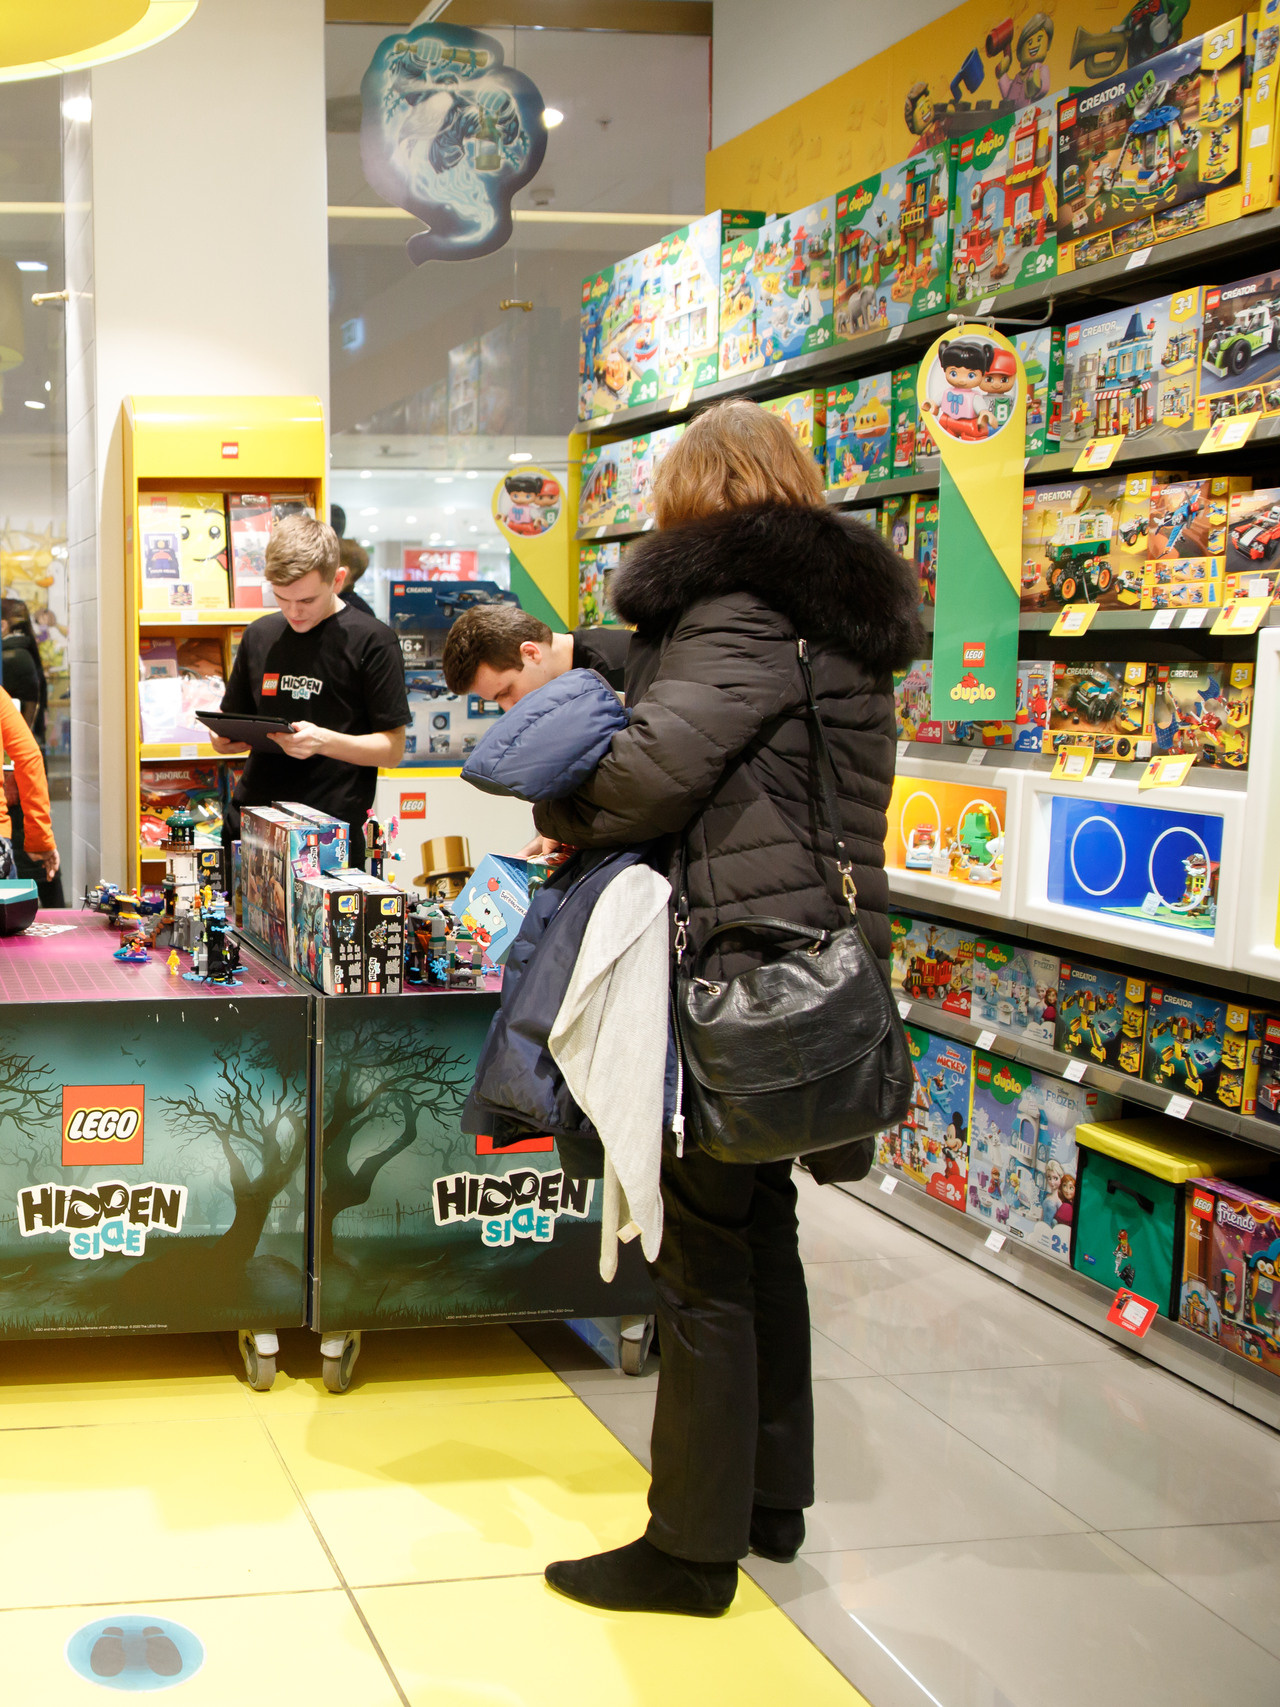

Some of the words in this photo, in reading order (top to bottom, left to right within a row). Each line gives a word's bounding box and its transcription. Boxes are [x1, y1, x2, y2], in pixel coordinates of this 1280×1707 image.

[1079, 83, 1126, 114] CREATOR
[976, 133, 1005, 157] duplo
[1059, 134, 1070, 148] 8+
[849, 192, 873, 213] duplo
[1036, 254, 1054, 274] 2+
[927, 291, 943, 309] 2+
[1222, 284, 1257, 301] CREATOR
[817, 328, 829, 345] 2+
[1082, 320, 1117, 338] CREATOR
[998, 404, 1009, 422] 8
[1038, 489, 1072, 503] CREATOR
[1160, 487, 1183, 496] CREATOR
[926, 510, 938, 523] dup
[418, 552, 462, 570] SALE
[400, 639, 422, 651] 16+
[964, 649, 984, 661] LEGO
[1066, 667, 1094, 675] CREATOR
[1170, 669, 1199, 678] CREATOR
[282, 676, 322, 694] HIDDEN
[293, 688, 310, 698] SIDE
[950, 683, 996, 704] duplo
[401, 798, 425, 811] LEGO
[959, 940, 974, 952] TOY
[987, 950, 1008, 964] duplo
[1072, 970, 1097, 983] CREATOR
[1164, 995, 1193, 1009] CREATOR
[1042, 1029, 1053, 1040] 2+
[1263, 1044, 1274, 1055] 7+
[937, 1054, 967, 1075] MICKEY
[993, 1074, 1022, 1095] duplo
[1046, 1090, 1079, 1112] FROZEN
[68, 1109, 139, 1141] LEGO
[436, 1171, 590, 1221] HIDDEN
[946, 1183, 962, 1202] 2+
[21, 1183, 182, 1232] HIDDEN
[1194, 1197, 1213, 1213] LEGO
[1217, 1201, 1256, 1234] Friends
[486, 1207, 551, 1243] SIDE
[1190, 1219, 1203, 1233] 7+
[74, 1220, 141, 1255] SIDE
[1052, 1235, 1069, 1254] 2+
